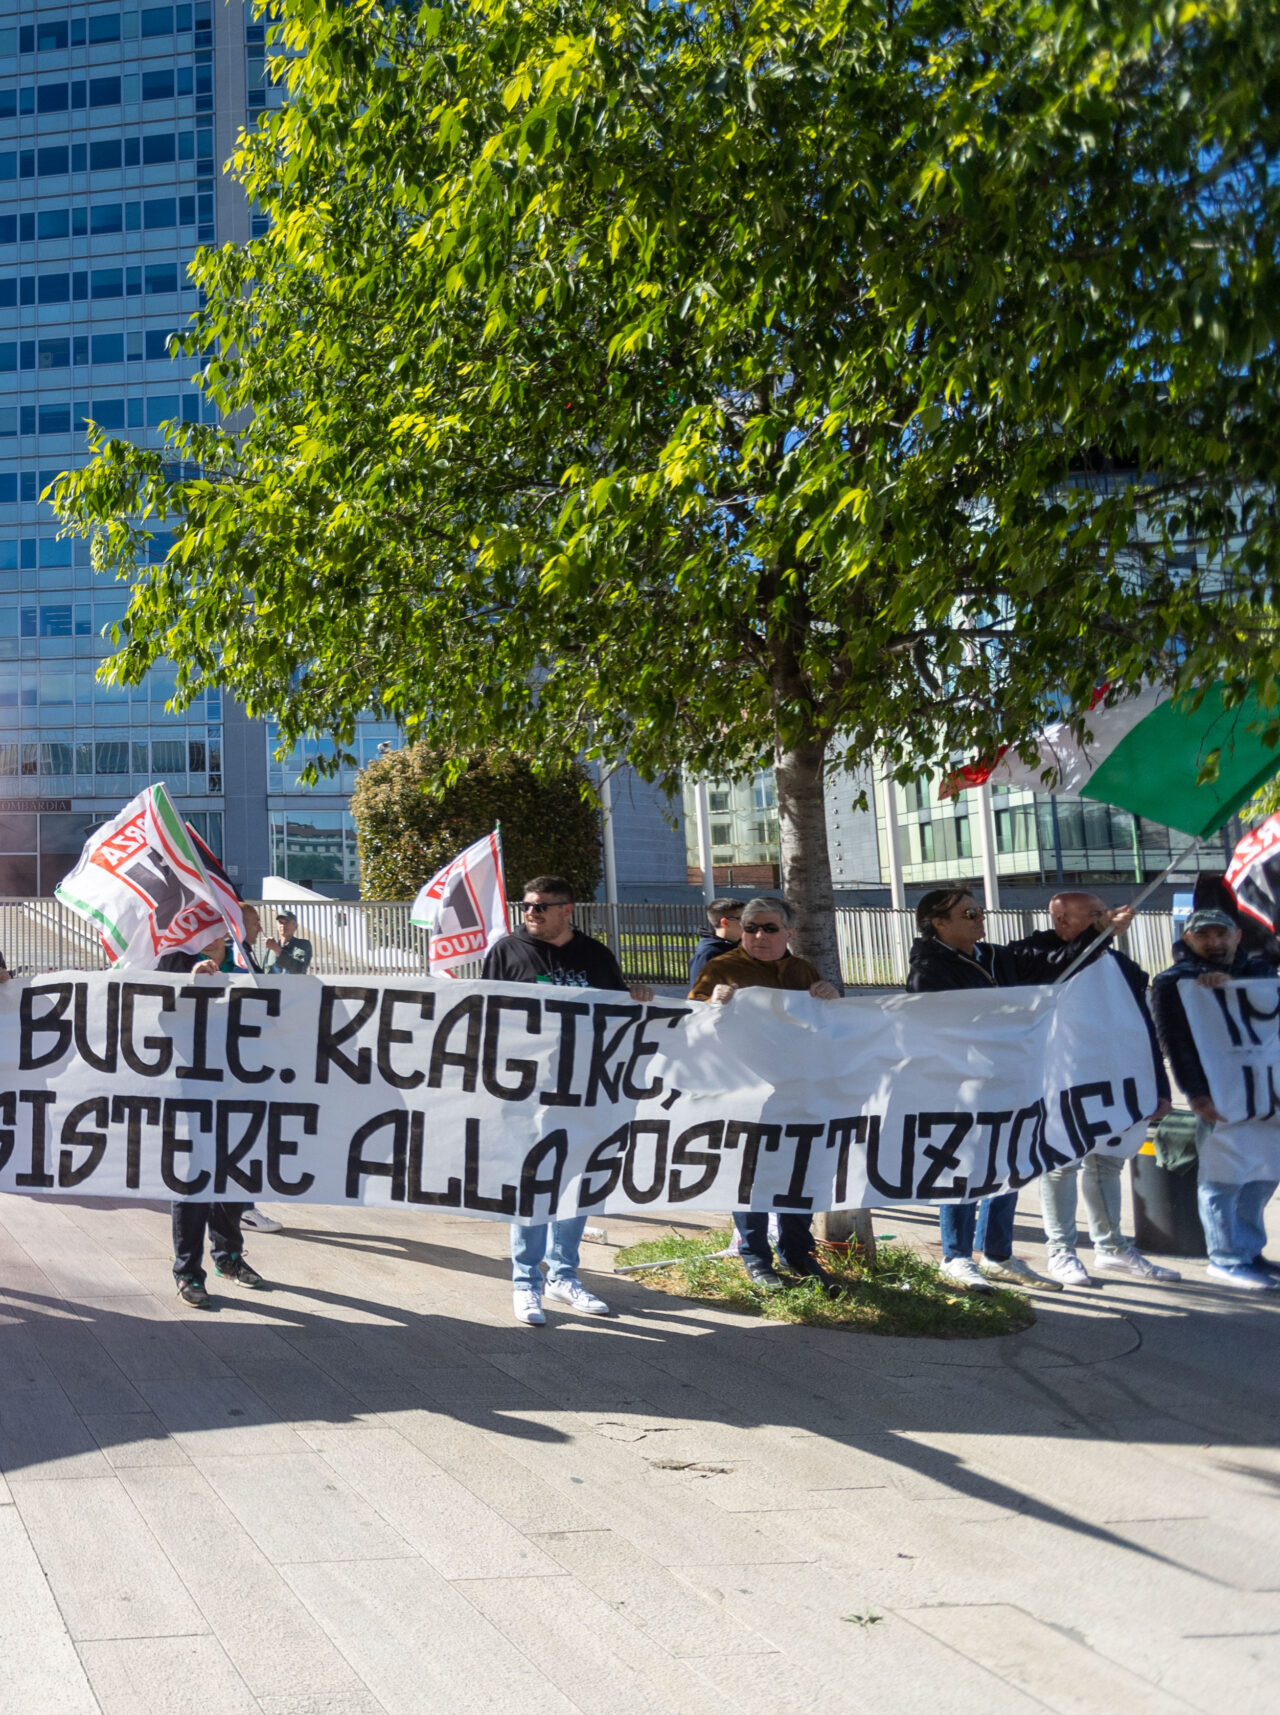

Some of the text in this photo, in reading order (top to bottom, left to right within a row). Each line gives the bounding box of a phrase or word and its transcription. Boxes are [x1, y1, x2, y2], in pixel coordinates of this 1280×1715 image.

[19, 982, 295, 1083] BUGIE.
[315, 985, 692, 1109] REAGIRE,
[346, 1109, 568, 1217] ALLA
